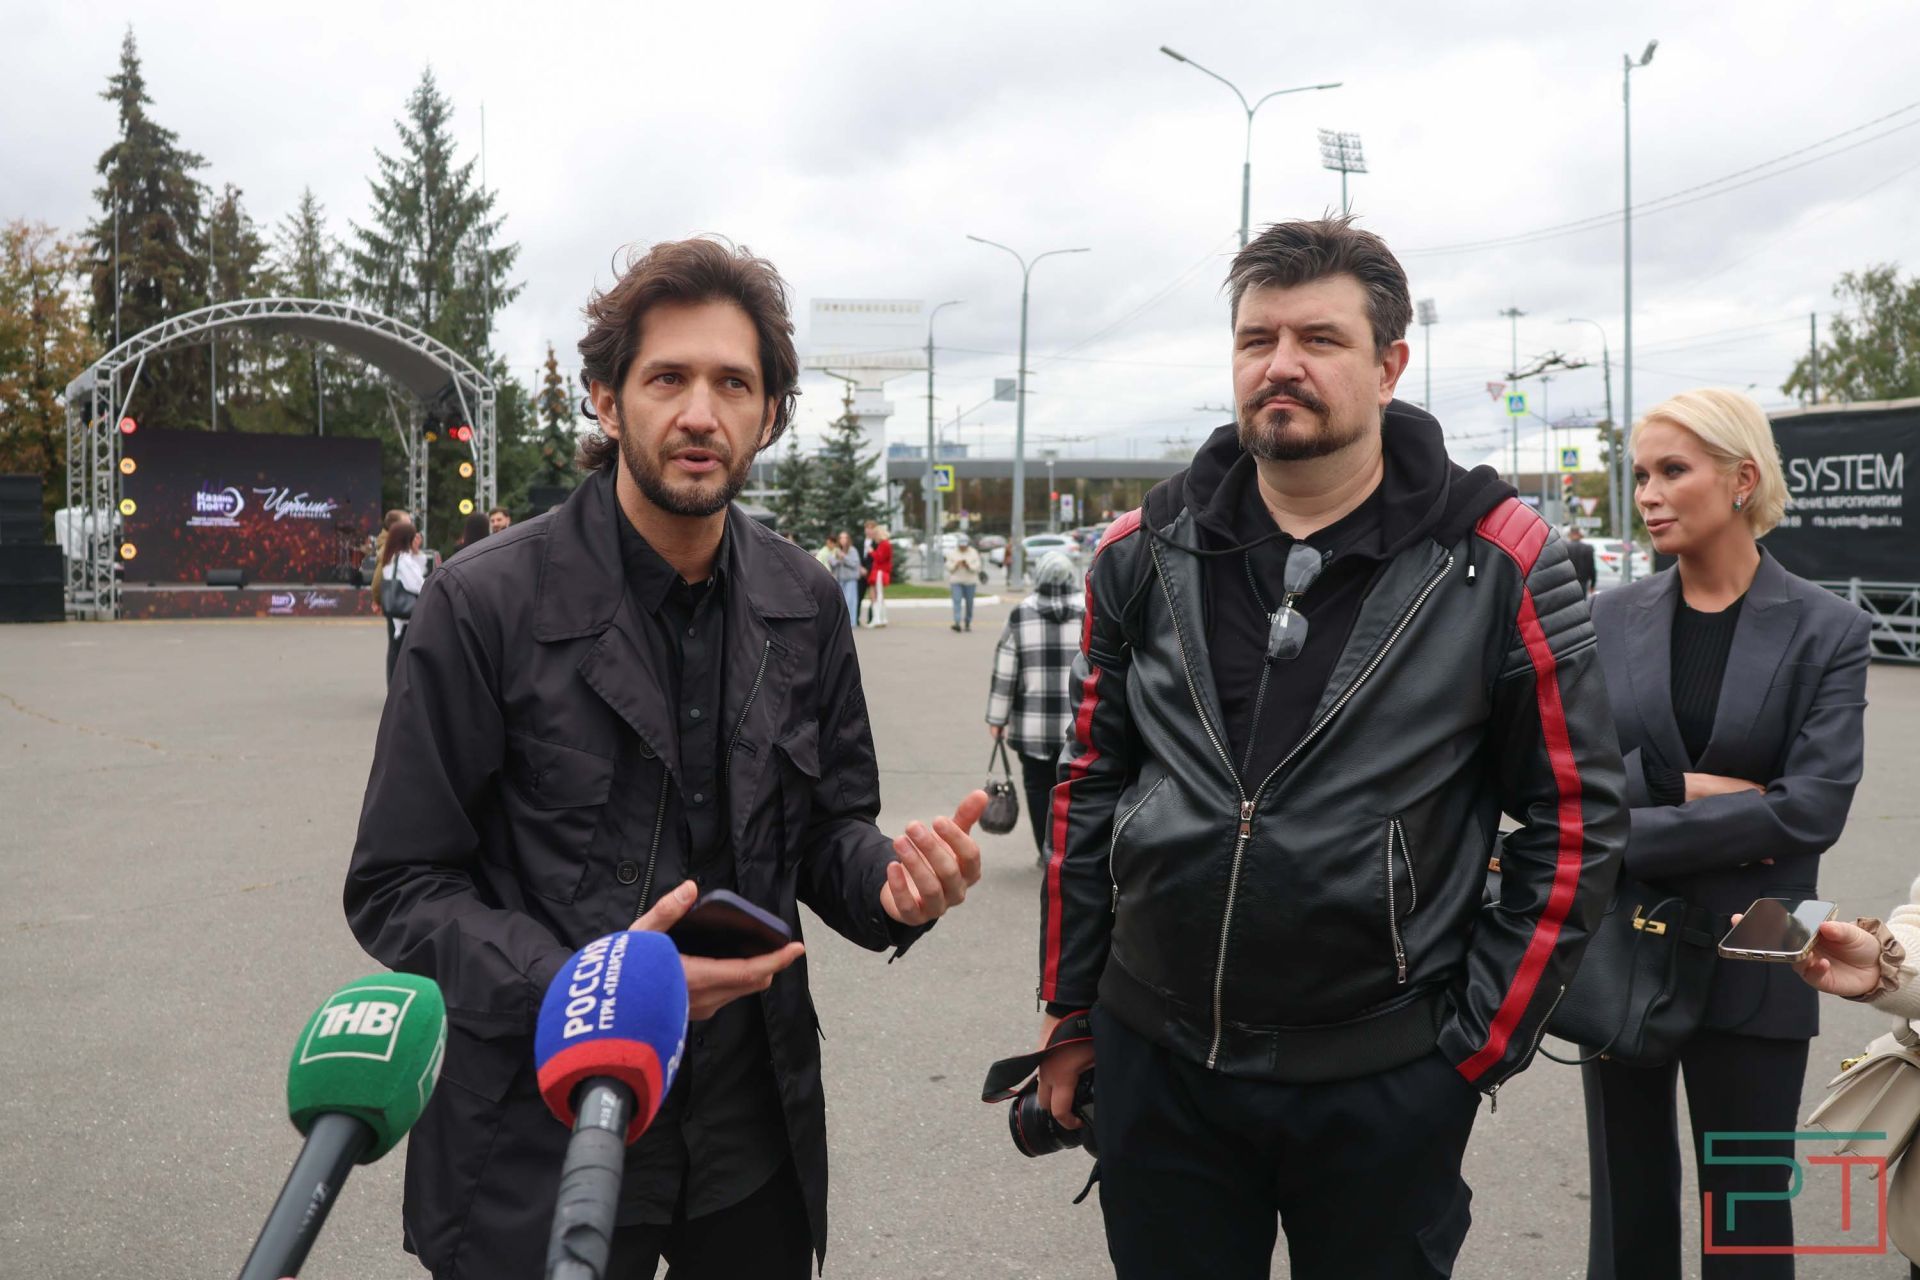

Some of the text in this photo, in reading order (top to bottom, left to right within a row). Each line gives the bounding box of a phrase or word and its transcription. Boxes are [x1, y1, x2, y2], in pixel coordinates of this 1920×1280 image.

[1789, 452, 1903, 492] SYSTEM
[196, 491, 234, 503] Казань
[563, 935, 614, 1039] РОССИЯ
[318, 1001, 400, 1038] ТНВ
[599, 997, 616, 1030] ГТРК
